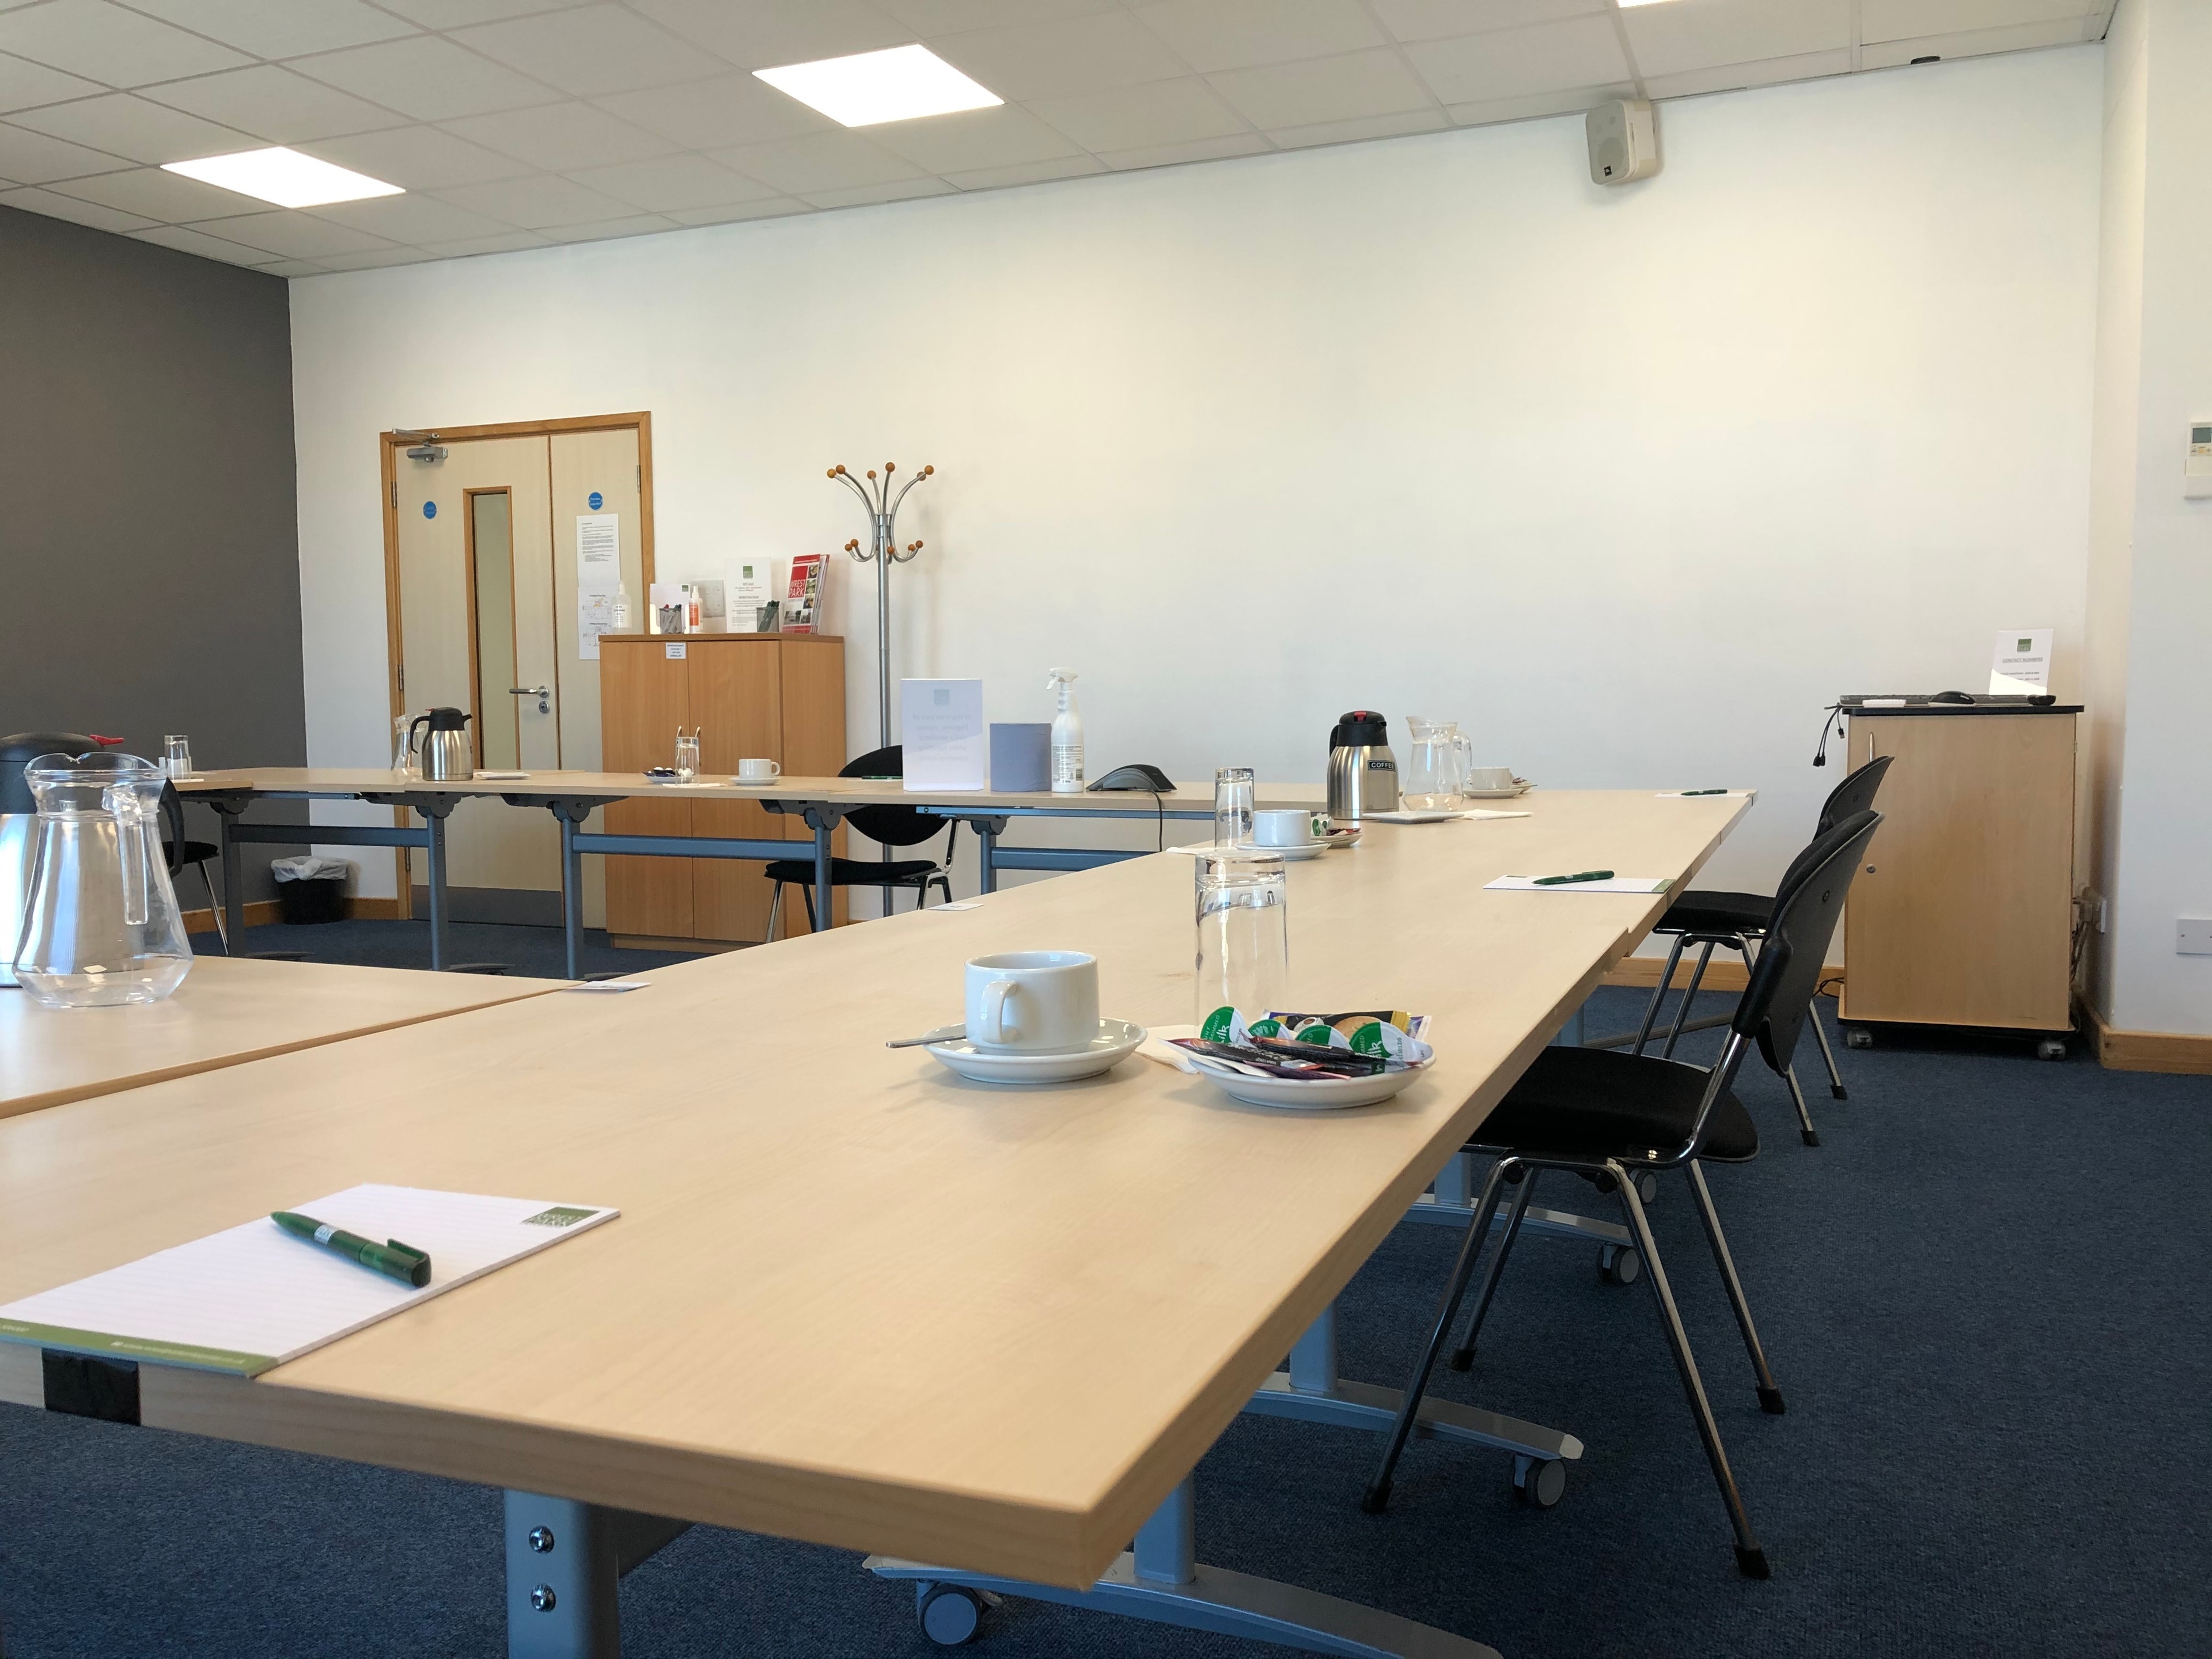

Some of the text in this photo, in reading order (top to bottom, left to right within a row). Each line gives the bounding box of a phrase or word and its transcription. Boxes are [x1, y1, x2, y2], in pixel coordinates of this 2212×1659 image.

[790, 579, 806, 588] WREST
[789, 588, 805, 597] PARK
[1210, 1014, 1220, 1040] SKIMMED
